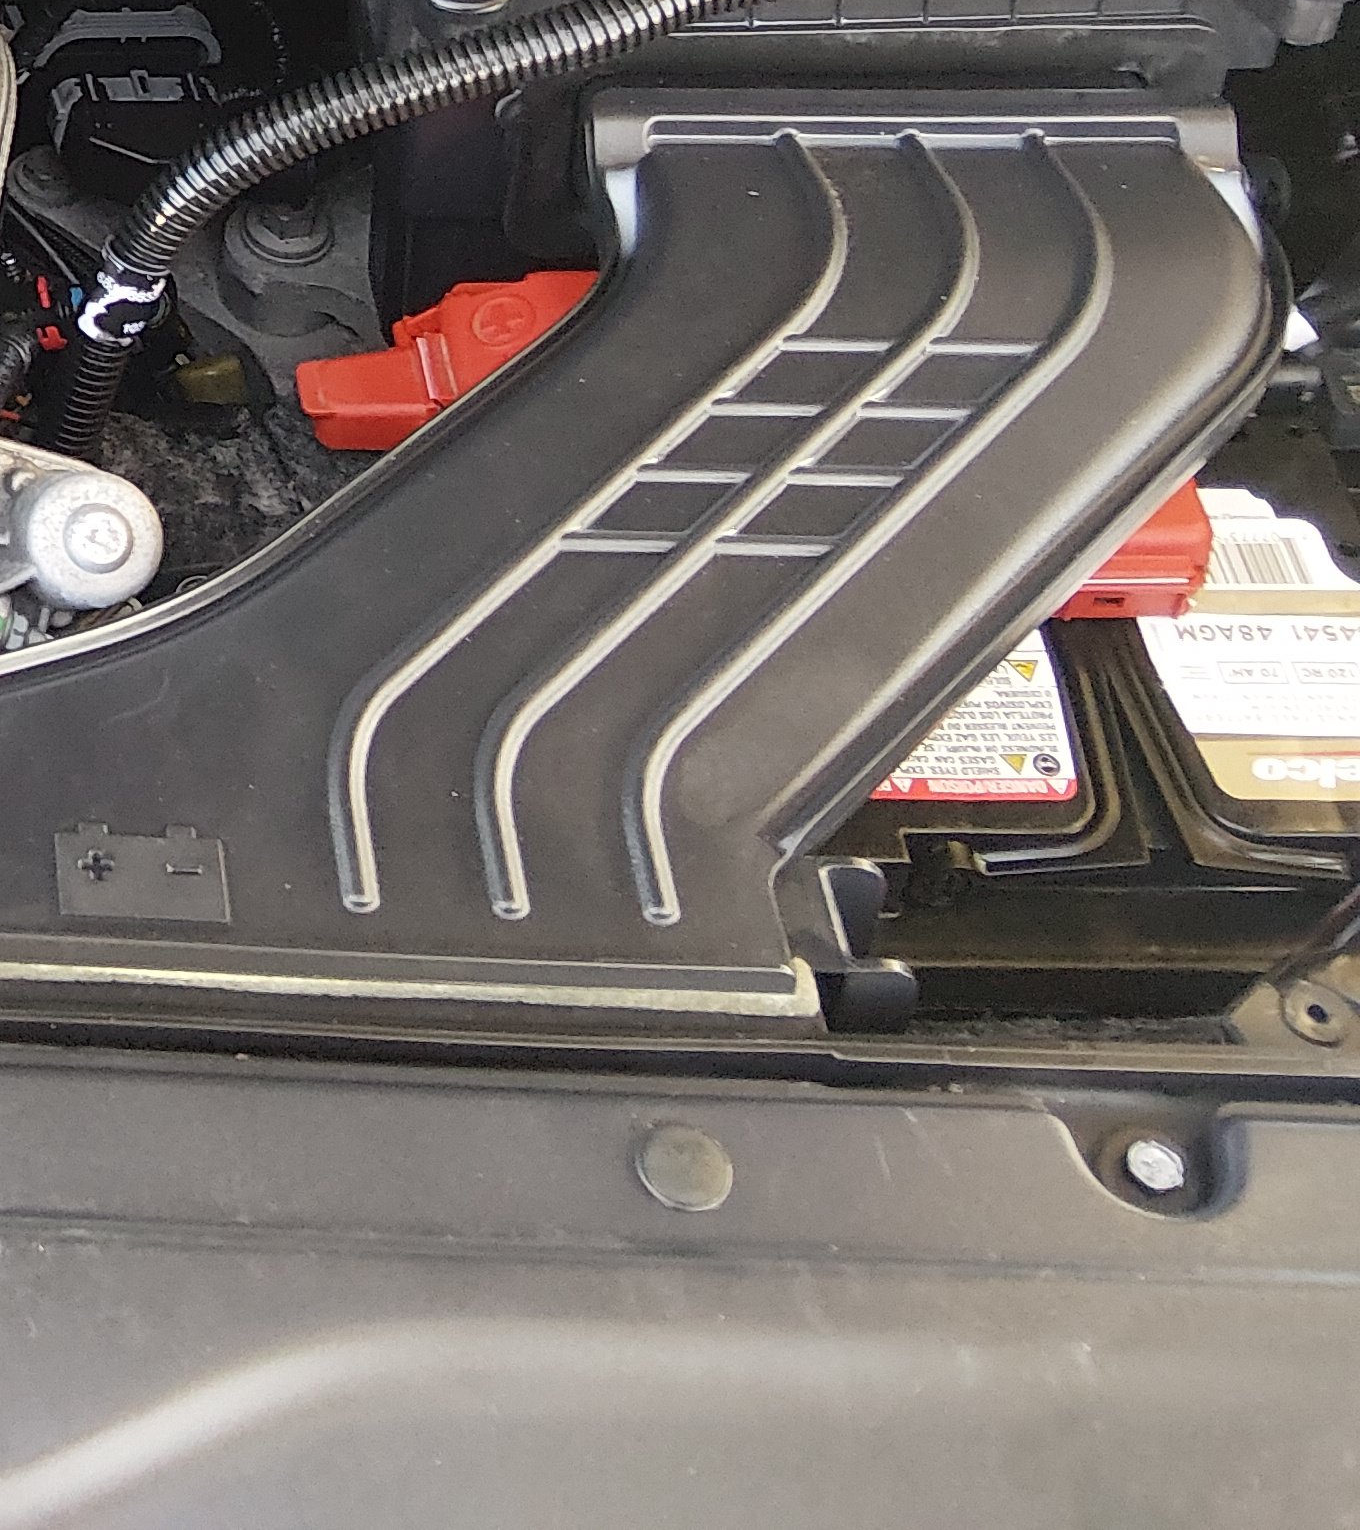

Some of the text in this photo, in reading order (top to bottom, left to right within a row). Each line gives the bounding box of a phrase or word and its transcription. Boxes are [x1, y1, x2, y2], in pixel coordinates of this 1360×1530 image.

[1173, 624, 1360, 642] 4541 48AGM
[1252, 758, 1360, 789] elco
